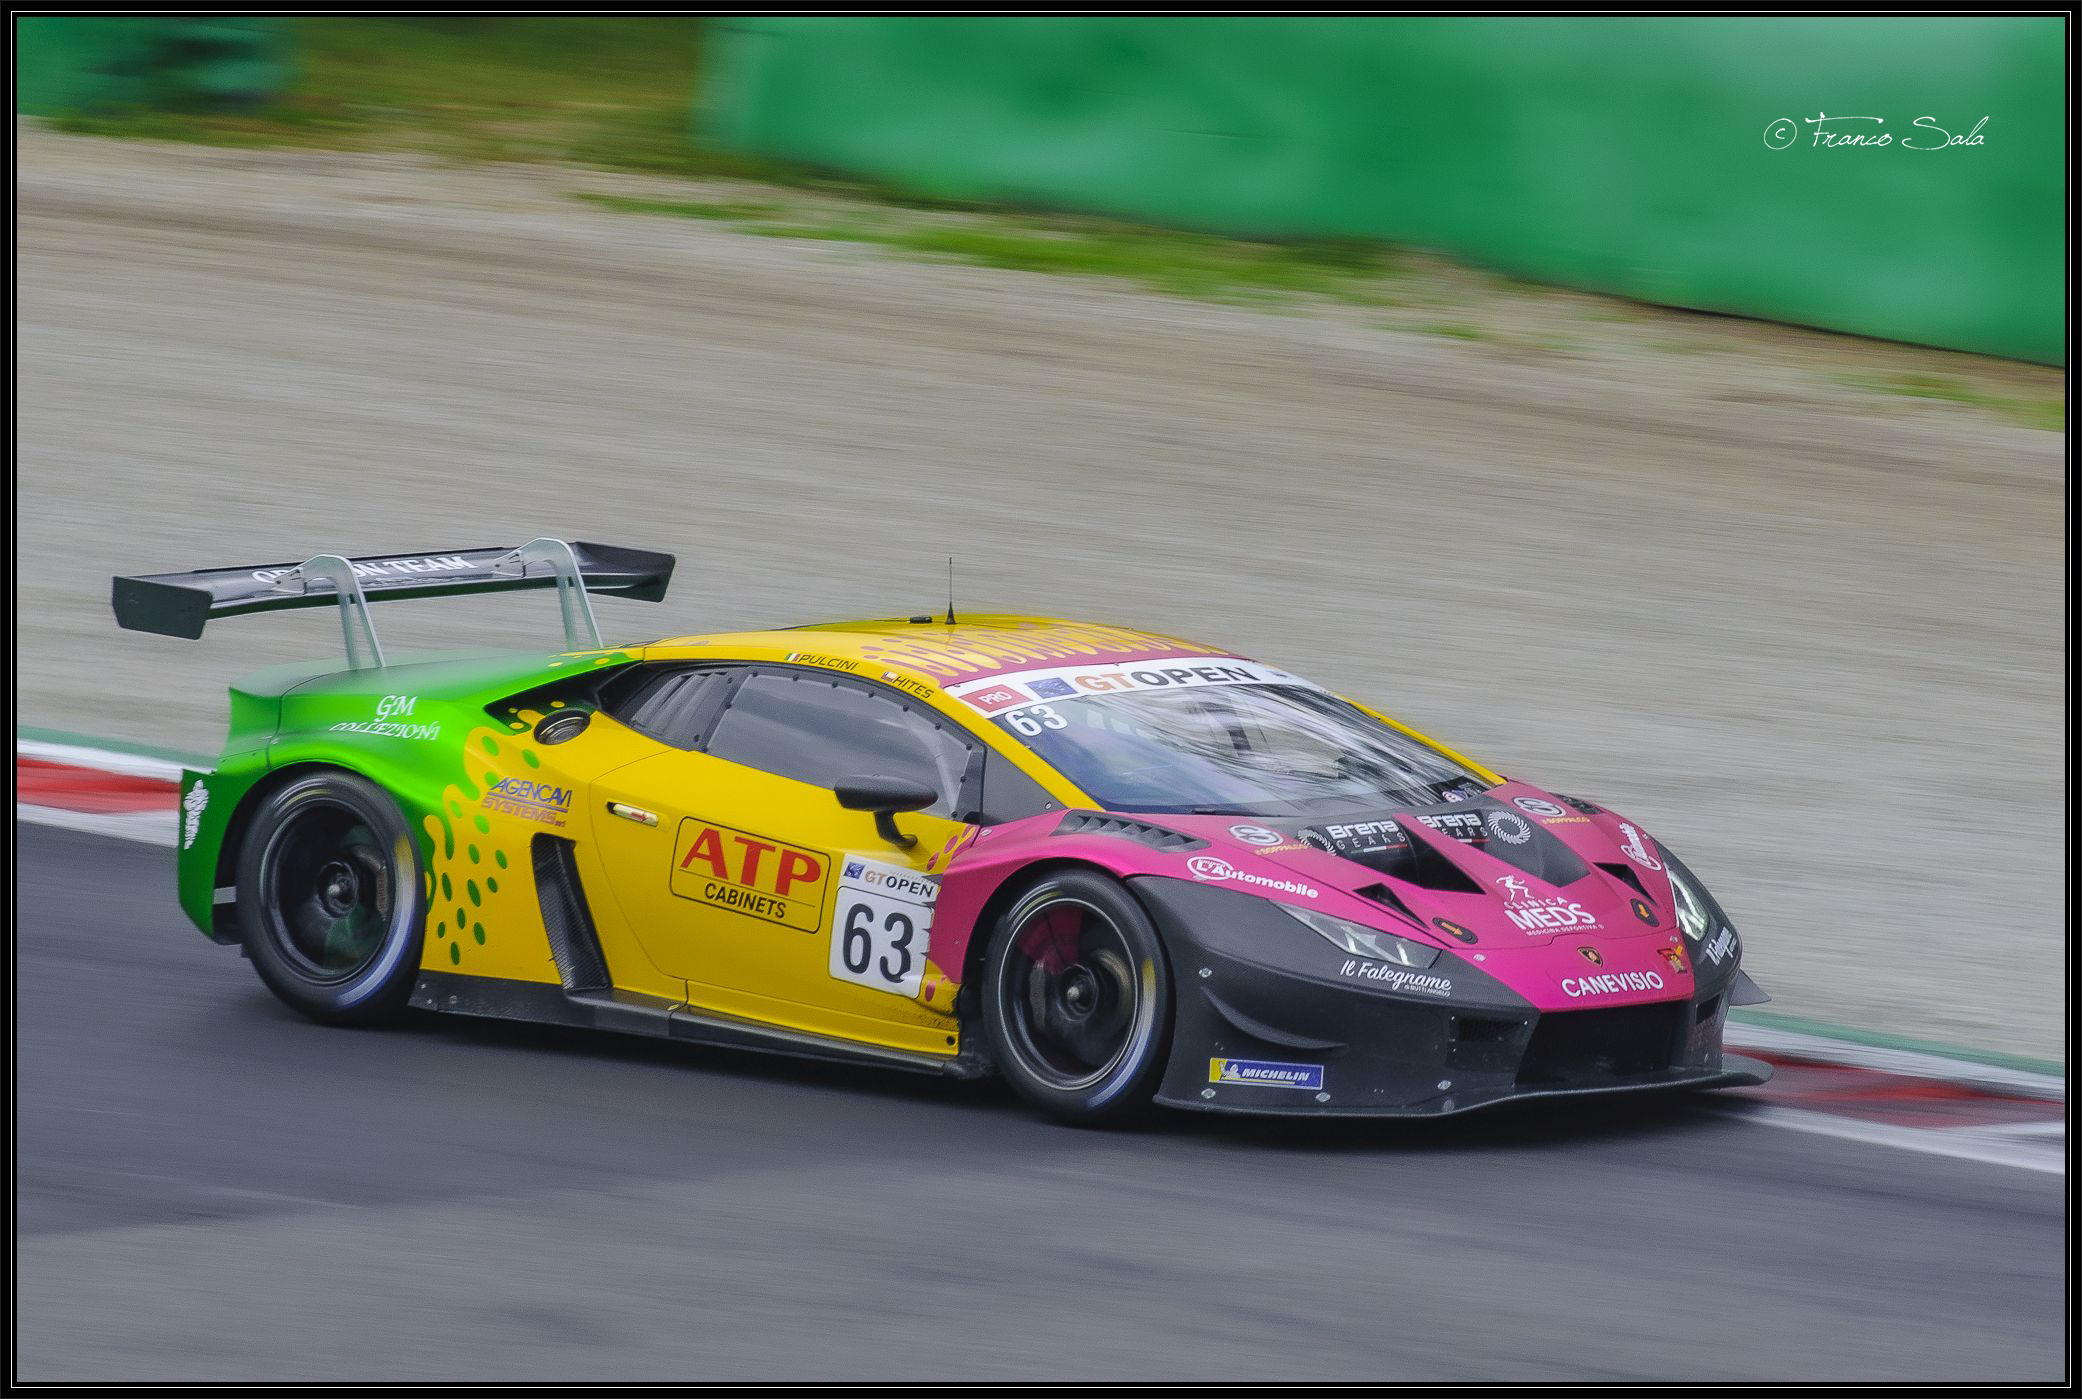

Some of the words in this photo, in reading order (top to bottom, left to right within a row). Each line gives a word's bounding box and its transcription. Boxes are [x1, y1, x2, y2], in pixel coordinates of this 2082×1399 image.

[385, 556, 478, 574] TEAM
[797, 653, 860, 671] PULCINI
[892, 675, 935, 700] HITES
[977, 691, 1013, 705] PRO
[373, 695, 418, 723] GM
[1004, 704, 1068, 737] 63
[328, 720, 441, 741] COLLEZIONI
[481, 796, 556, 825] SYSTEMS
[679, 827, 822, 898] ATP
[704, 882, 787, 920] CABINETS
[1503, 896, 1568, 911] CLINICA
[1503, 903, 1596, 930] MEDS
[842, 902, 914, 984] 63
[1357, 961, 1453, 992] Falegname
[1561, 970, 1665, 998] CANEVISIO
[1241, 1068, 1311, 1083] MICHELIN
